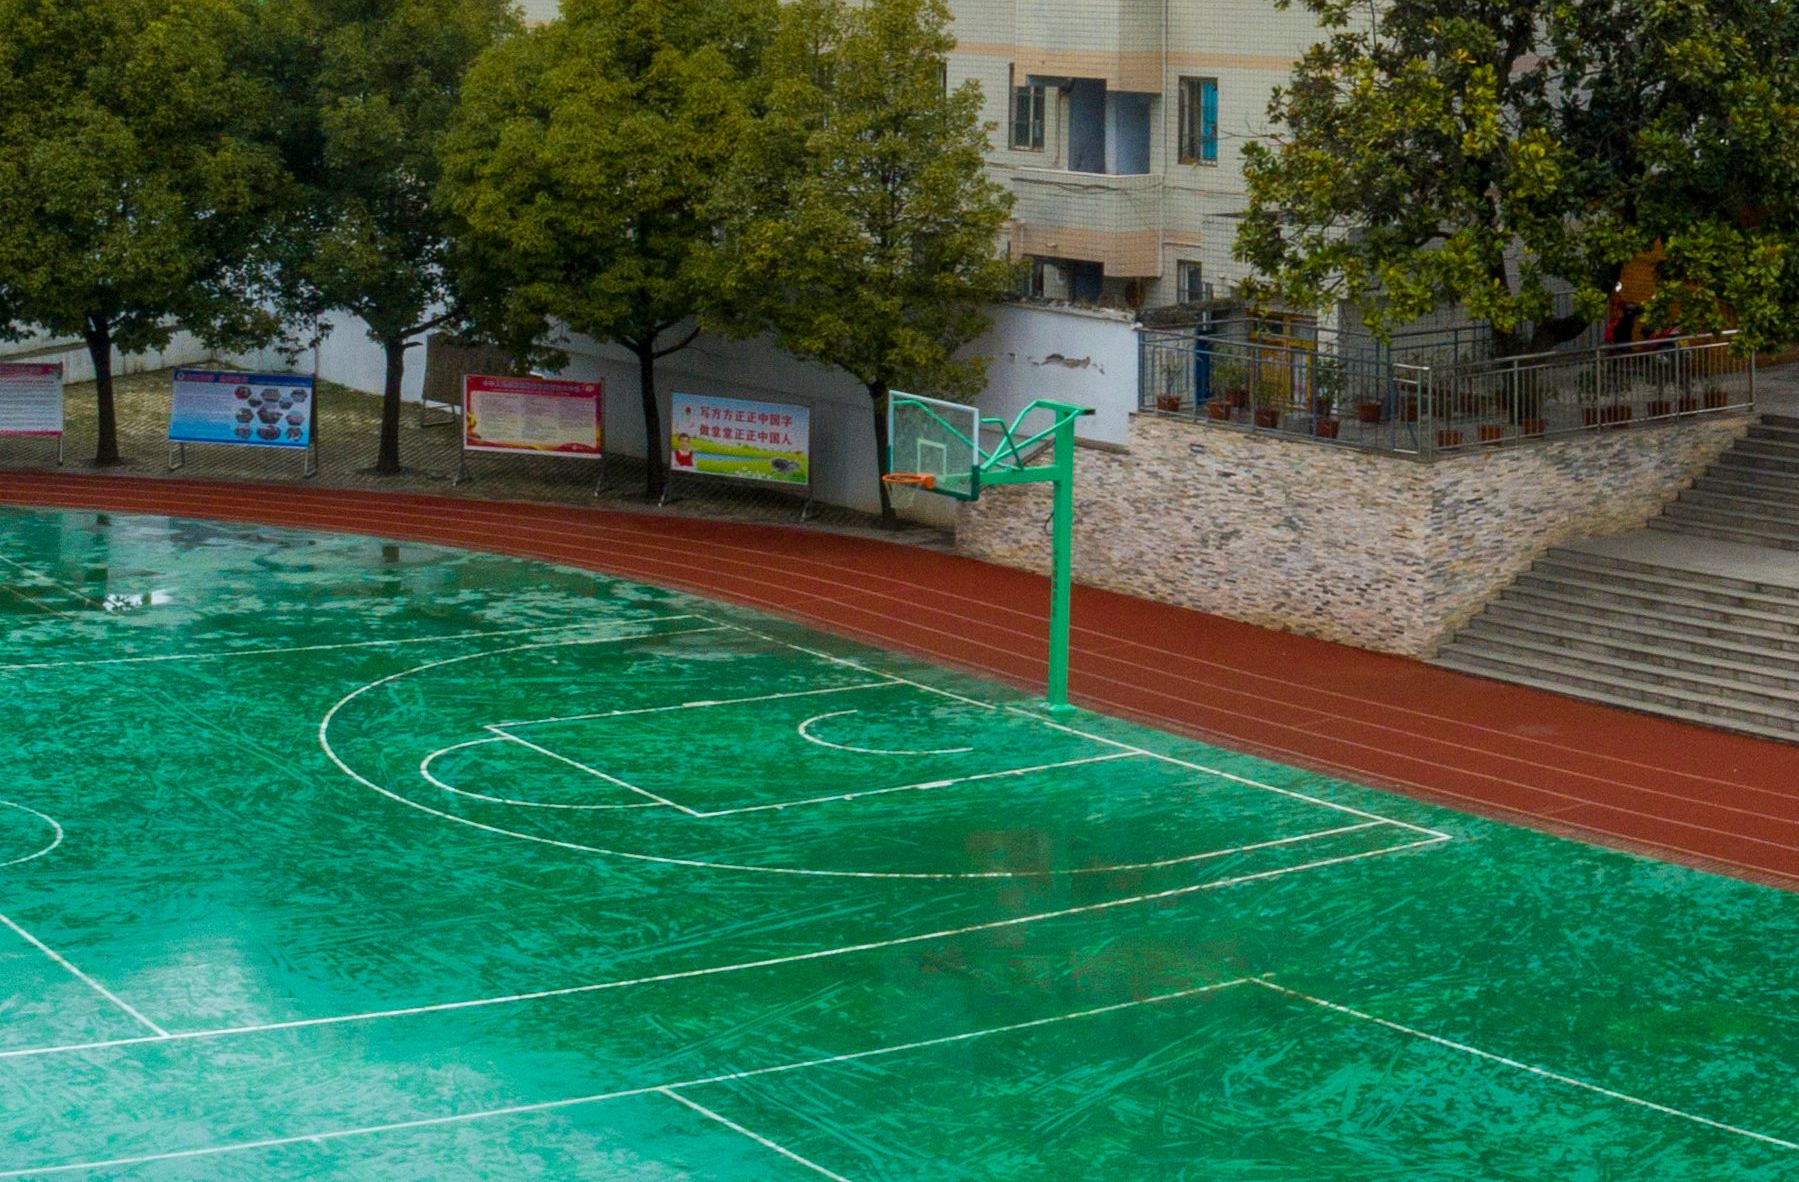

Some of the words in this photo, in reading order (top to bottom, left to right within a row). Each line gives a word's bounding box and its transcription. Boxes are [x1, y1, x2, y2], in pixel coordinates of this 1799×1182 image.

[700, 406, 793, 427] 写方方正正中国字
[699, 423, 793, 446] 做堂堂正正中国人
